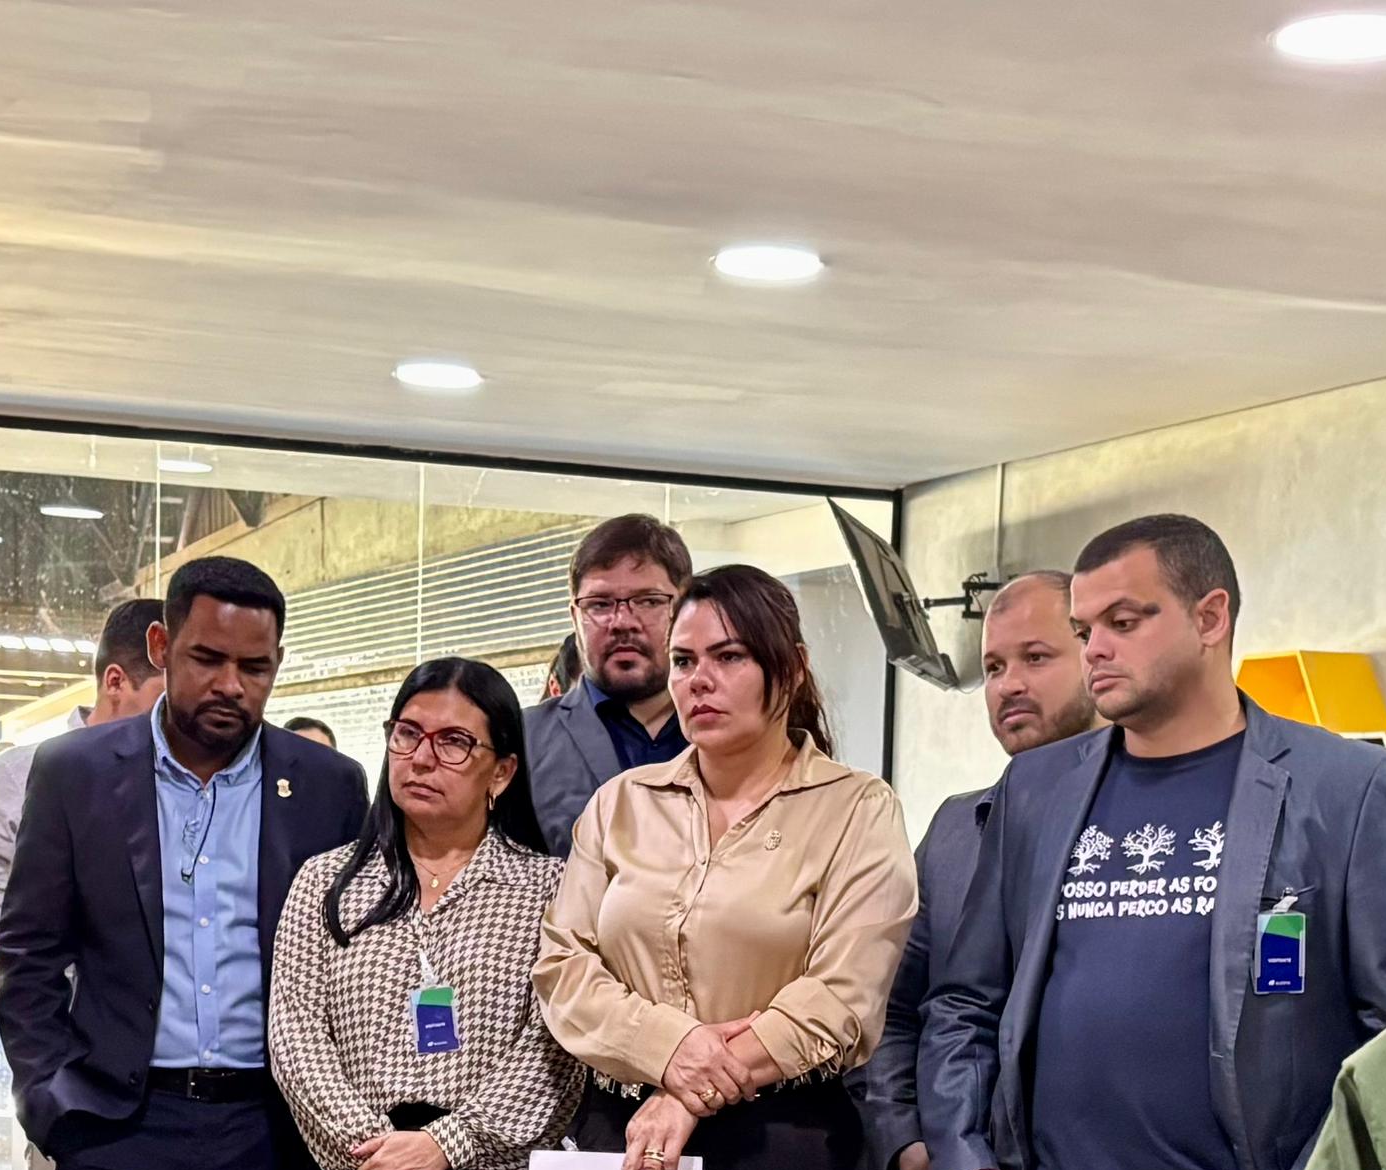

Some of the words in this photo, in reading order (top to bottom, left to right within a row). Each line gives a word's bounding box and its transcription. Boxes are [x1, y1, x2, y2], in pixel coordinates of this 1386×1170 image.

[1060, 880, 1107, 898] OSSO
[1109, 877, 1166, 897] PERDER
[1168, 876, 1190, 894] AS
[1193, 875, 1217, 892] FO
[1067, 901, 1114, 920] NUNCA
[1117, 898, 1168, 918] PERCO
[1170, 896, 1192, 915] AS
